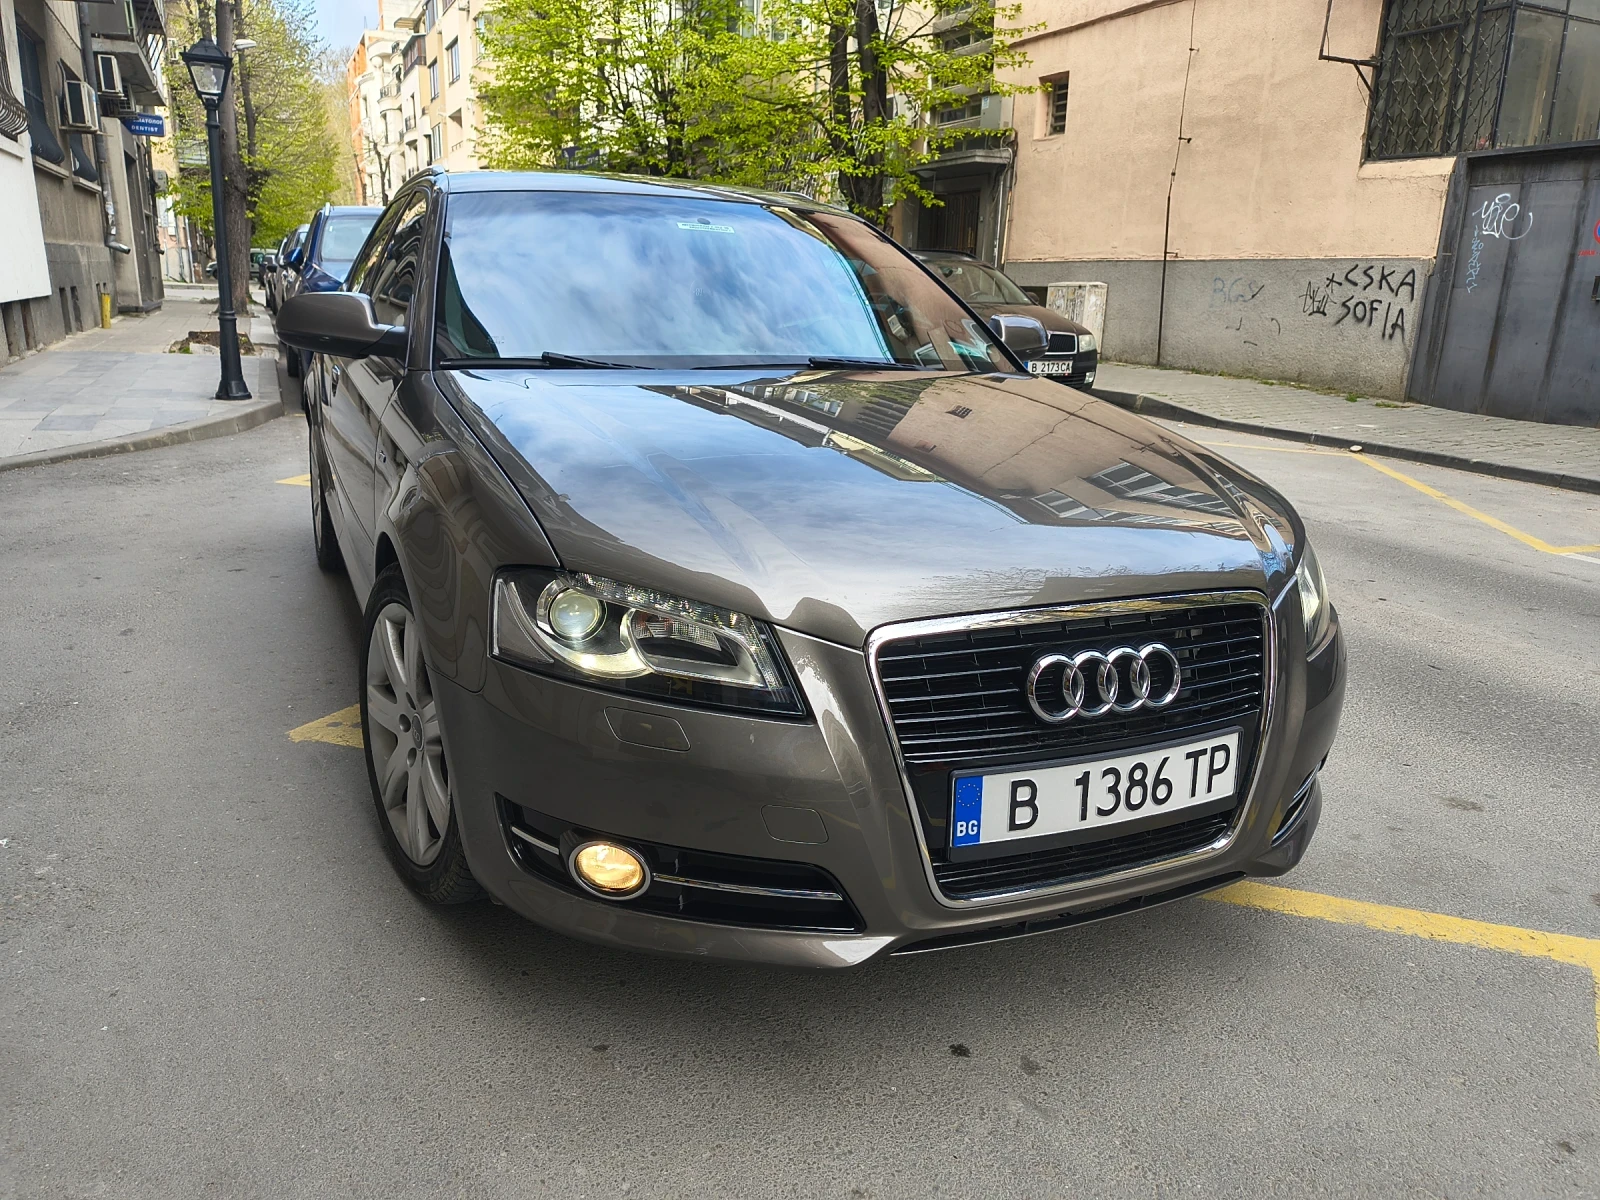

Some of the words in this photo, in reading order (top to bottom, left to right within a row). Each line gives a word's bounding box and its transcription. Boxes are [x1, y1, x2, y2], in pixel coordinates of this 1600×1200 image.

[1344, 264, 1416, 302] CSKA
[1334, 295, 1406, 341] SOFIA
[1031, 362, 1038, 373] B
[1008, 778, 1039, 832] B
[1074, 756, 1174, 822] 1386
[1185, 743, 1232, 799] TP
[956, 819, 979, 837] BG
